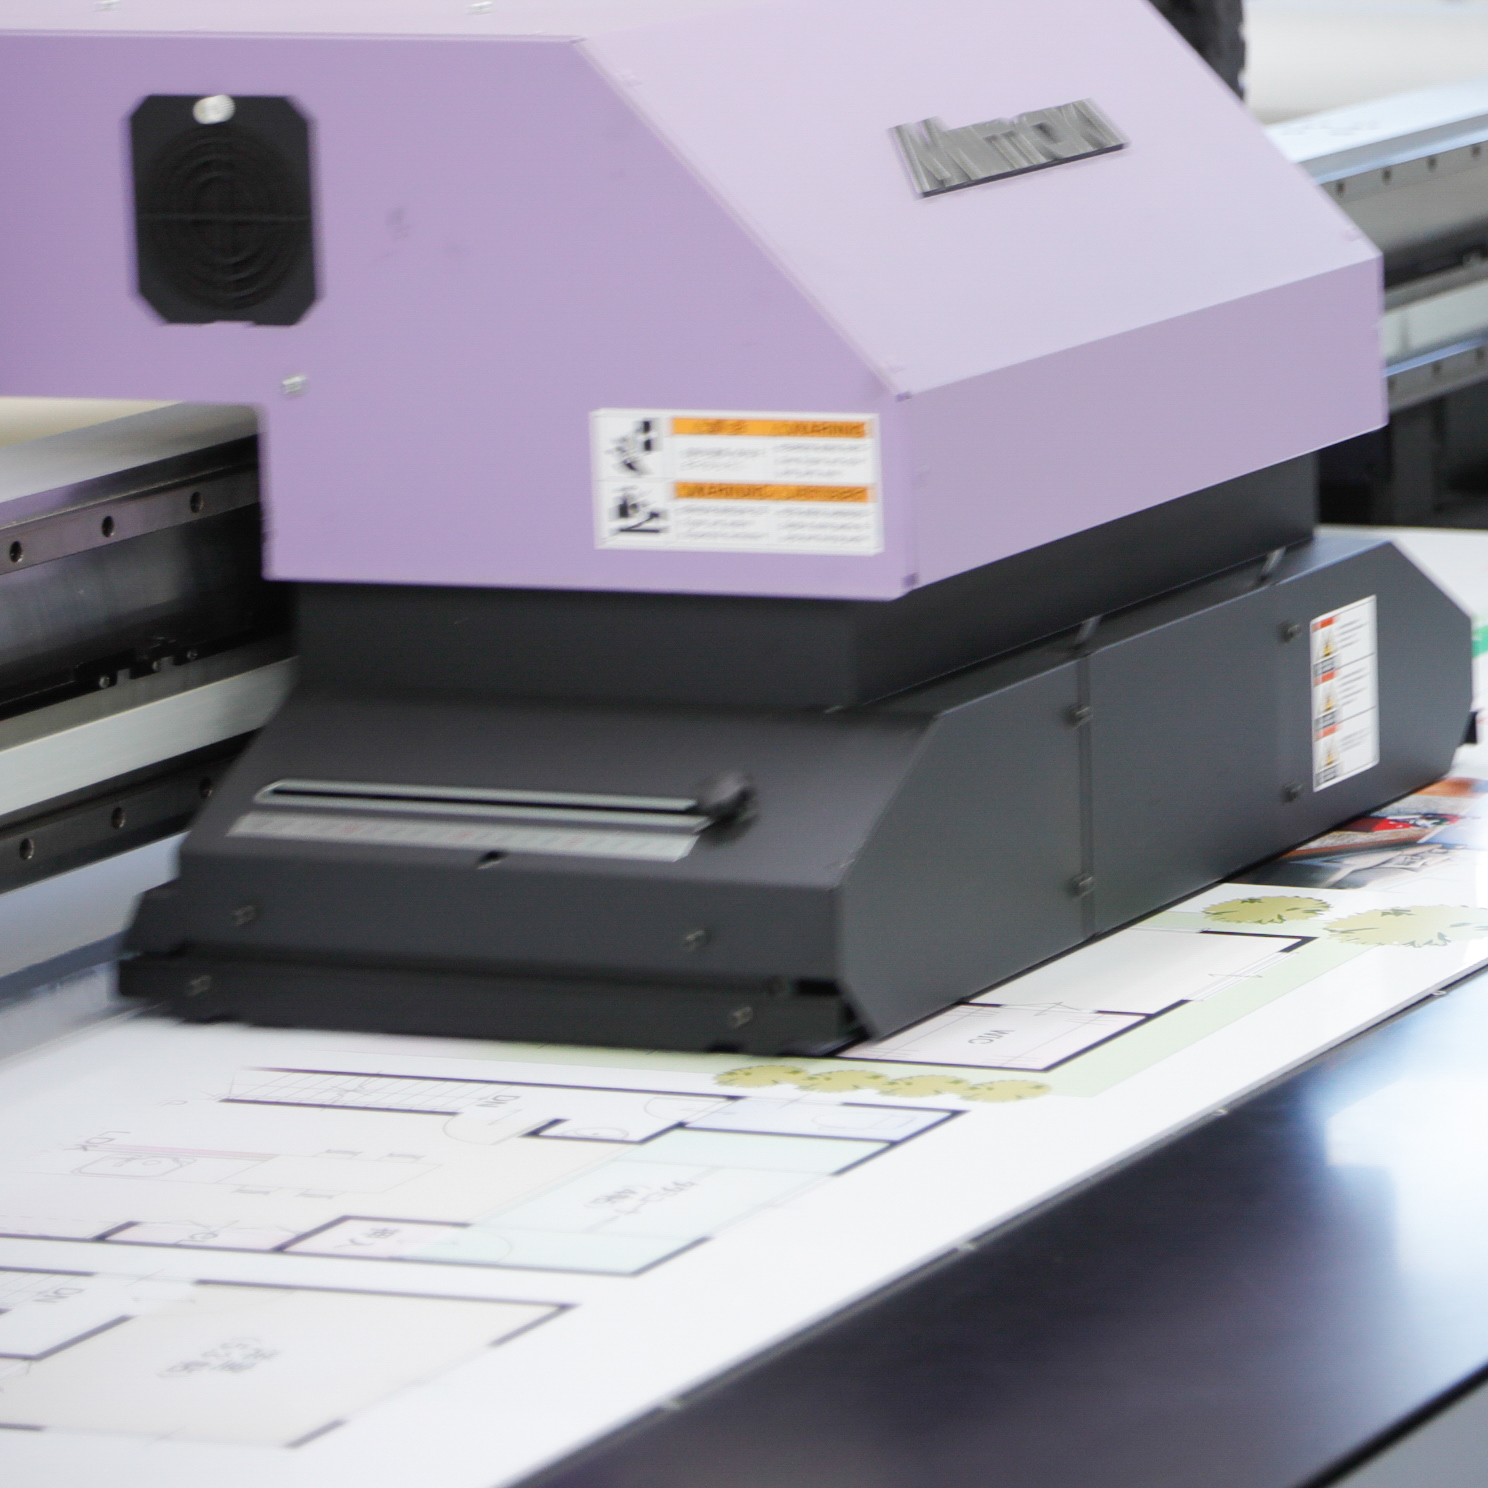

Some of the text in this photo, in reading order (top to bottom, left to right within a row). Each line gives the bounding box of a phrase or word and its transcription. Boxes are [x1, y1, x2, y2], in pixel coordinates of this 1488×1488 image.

[967, 1028, 1015, 1045] WIC
[475, 1094, 521, 1108] DN
[62, 1130, 132, 1152] LDK
[32, 1287, 86, 1303] DN
